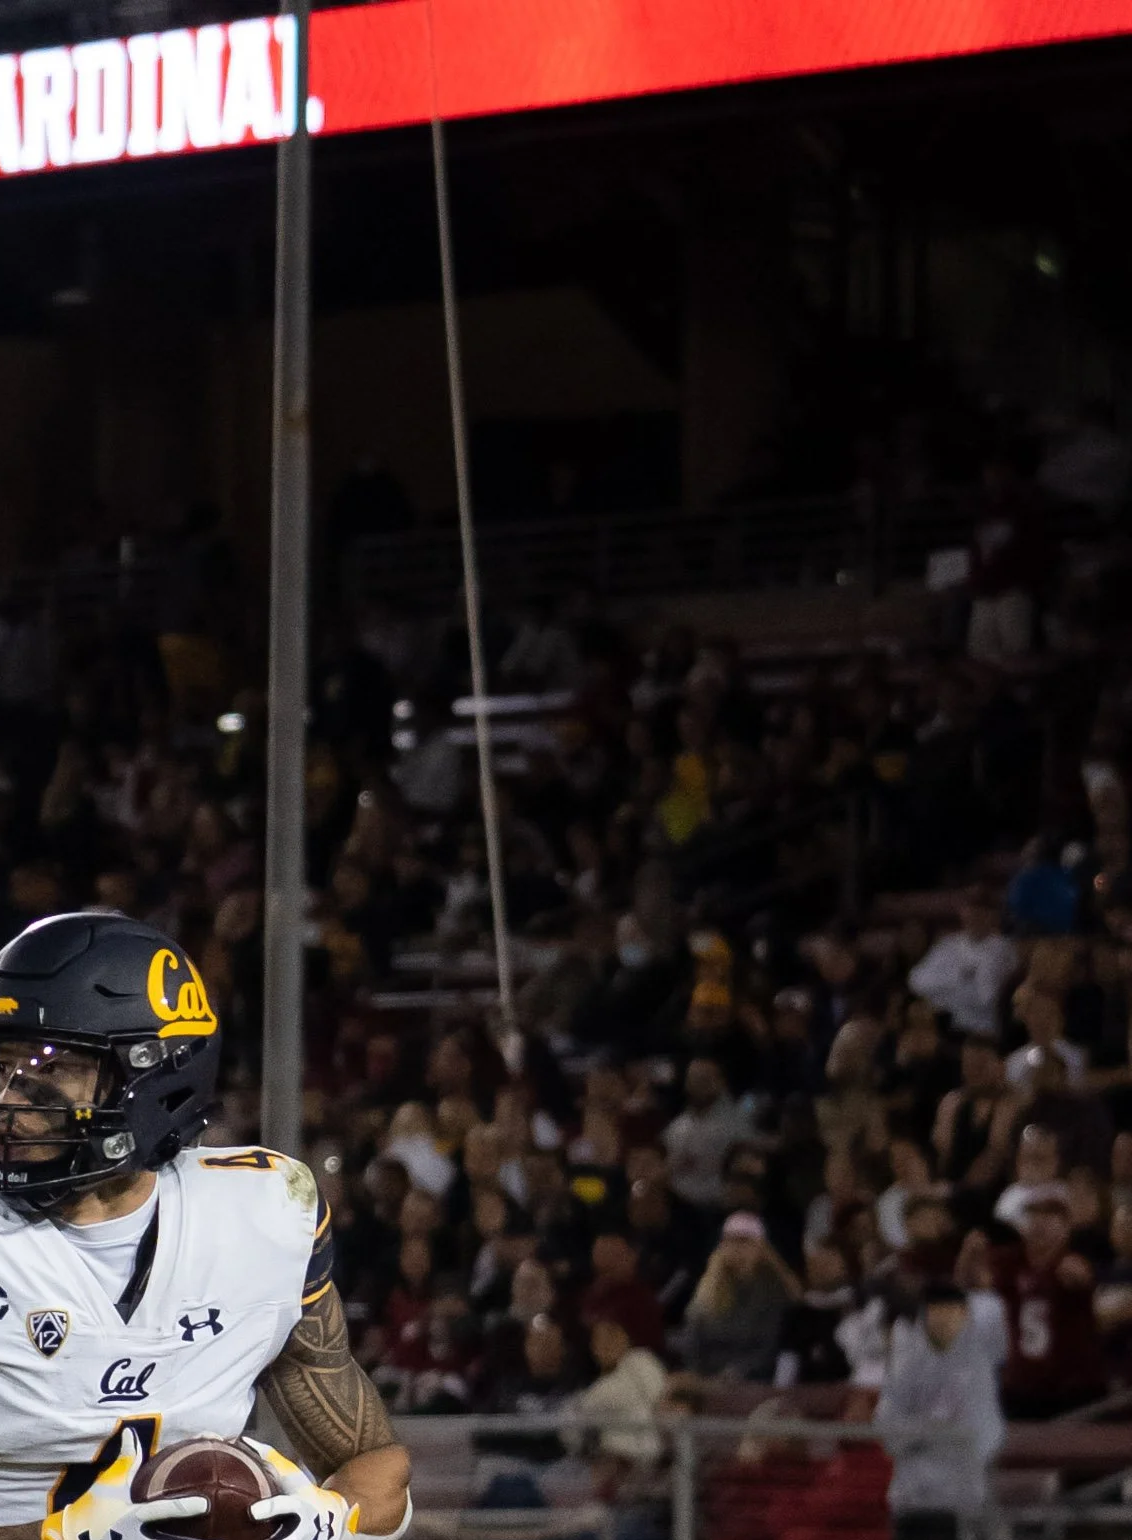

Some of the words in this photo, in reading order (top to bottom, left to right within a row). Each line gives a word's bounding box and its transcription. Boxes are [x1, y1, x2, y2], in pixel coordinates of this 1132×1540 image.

[147, 948, 218, 1039] Cal
[30, 1311, 67, 1339] PAC
[38, 1330, 59, 1349] 12
[97, 1358, 157, 1404] Cal
